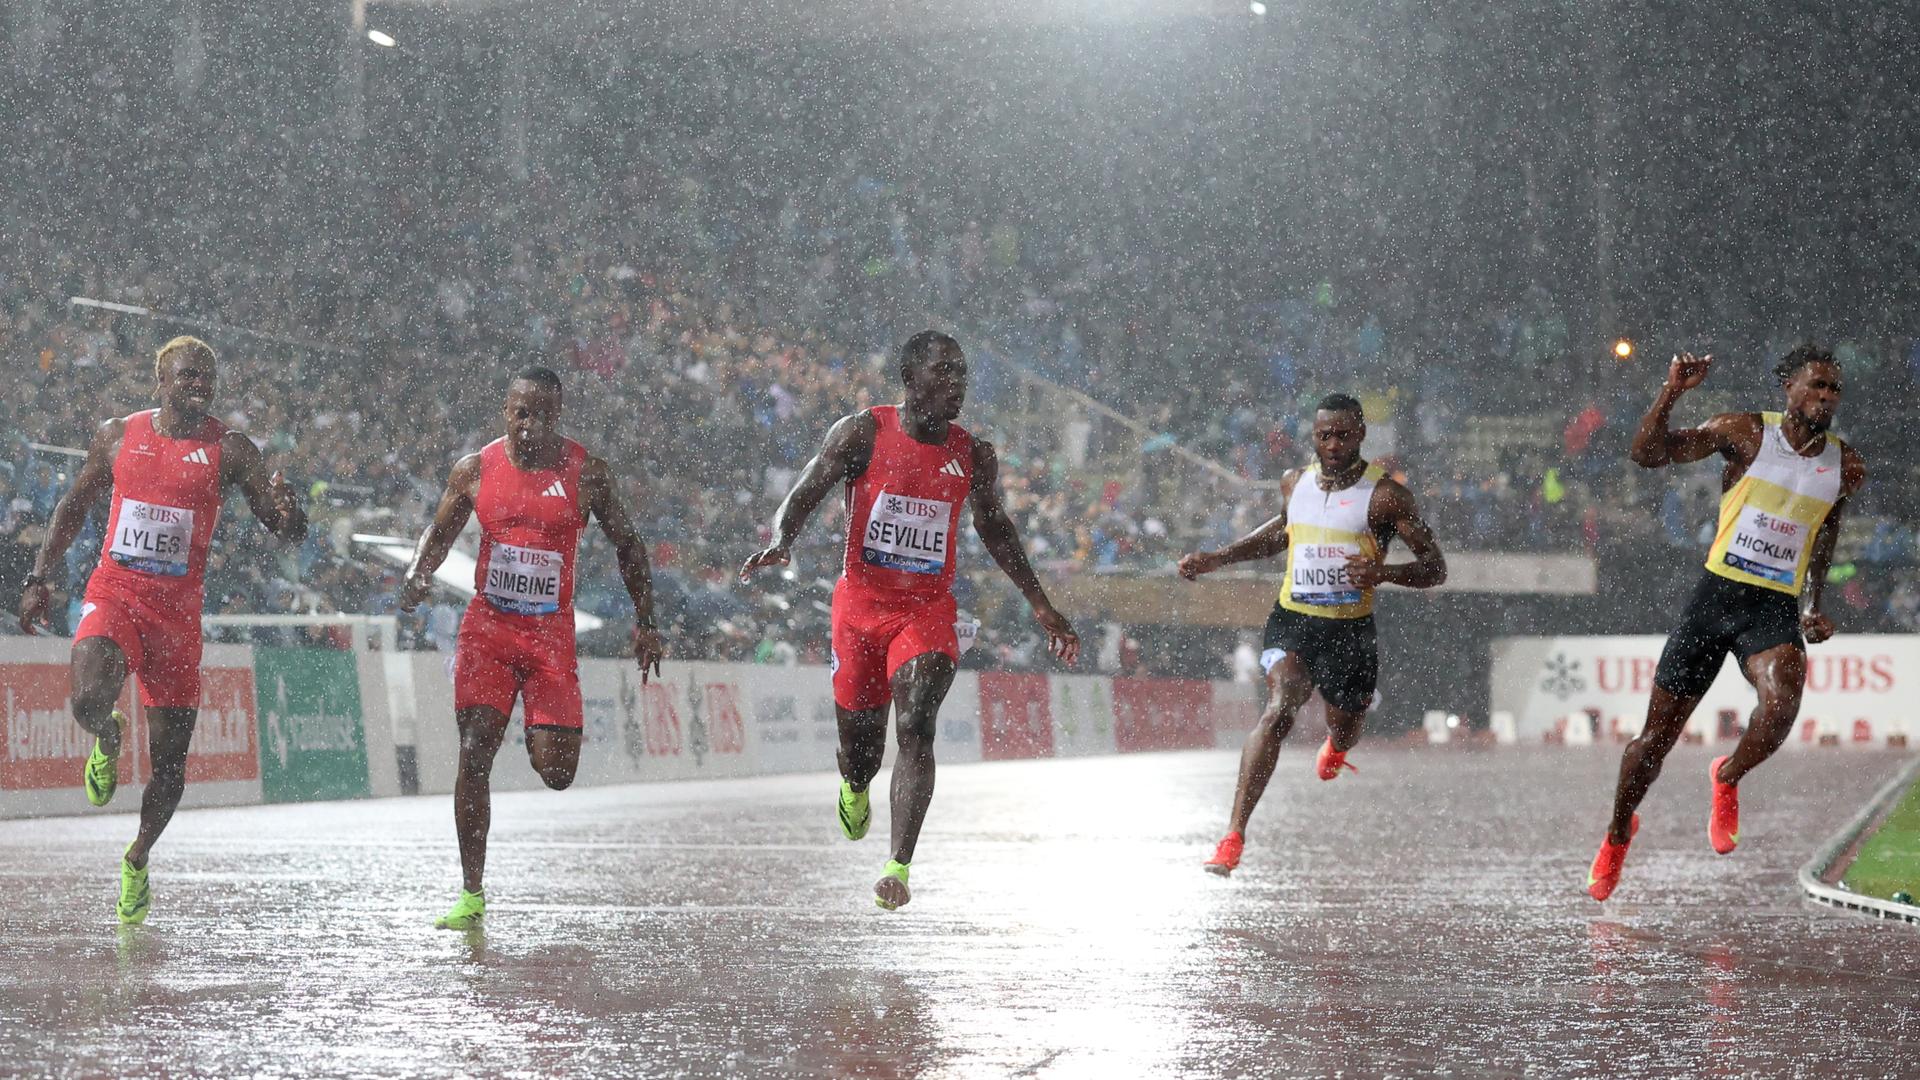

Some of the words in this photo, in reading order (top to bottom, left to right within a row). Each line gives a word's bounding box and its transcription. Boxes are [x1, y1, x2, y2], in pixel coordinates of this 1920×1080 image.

[149, 508, 180, 524] UBS
[906, 501, 938, 518] UBS
[869, 520, 943, 553] SEVILLE
[1770, 518, 1798, 536] UBS
[123, 528, 180, 554] LYLES
[1736, 533, 1796, 562] HICKLIN
[520, 551, 550, 567] UBS
[1317, 546, 1345, 559] UBS
[490, 569, 557, 596] SIMBINE
[1295, 568, 1347, 586] LINDSE
[1595, 655, 1657, 693] UB
[1804, 655, 1895, 693] UBS
